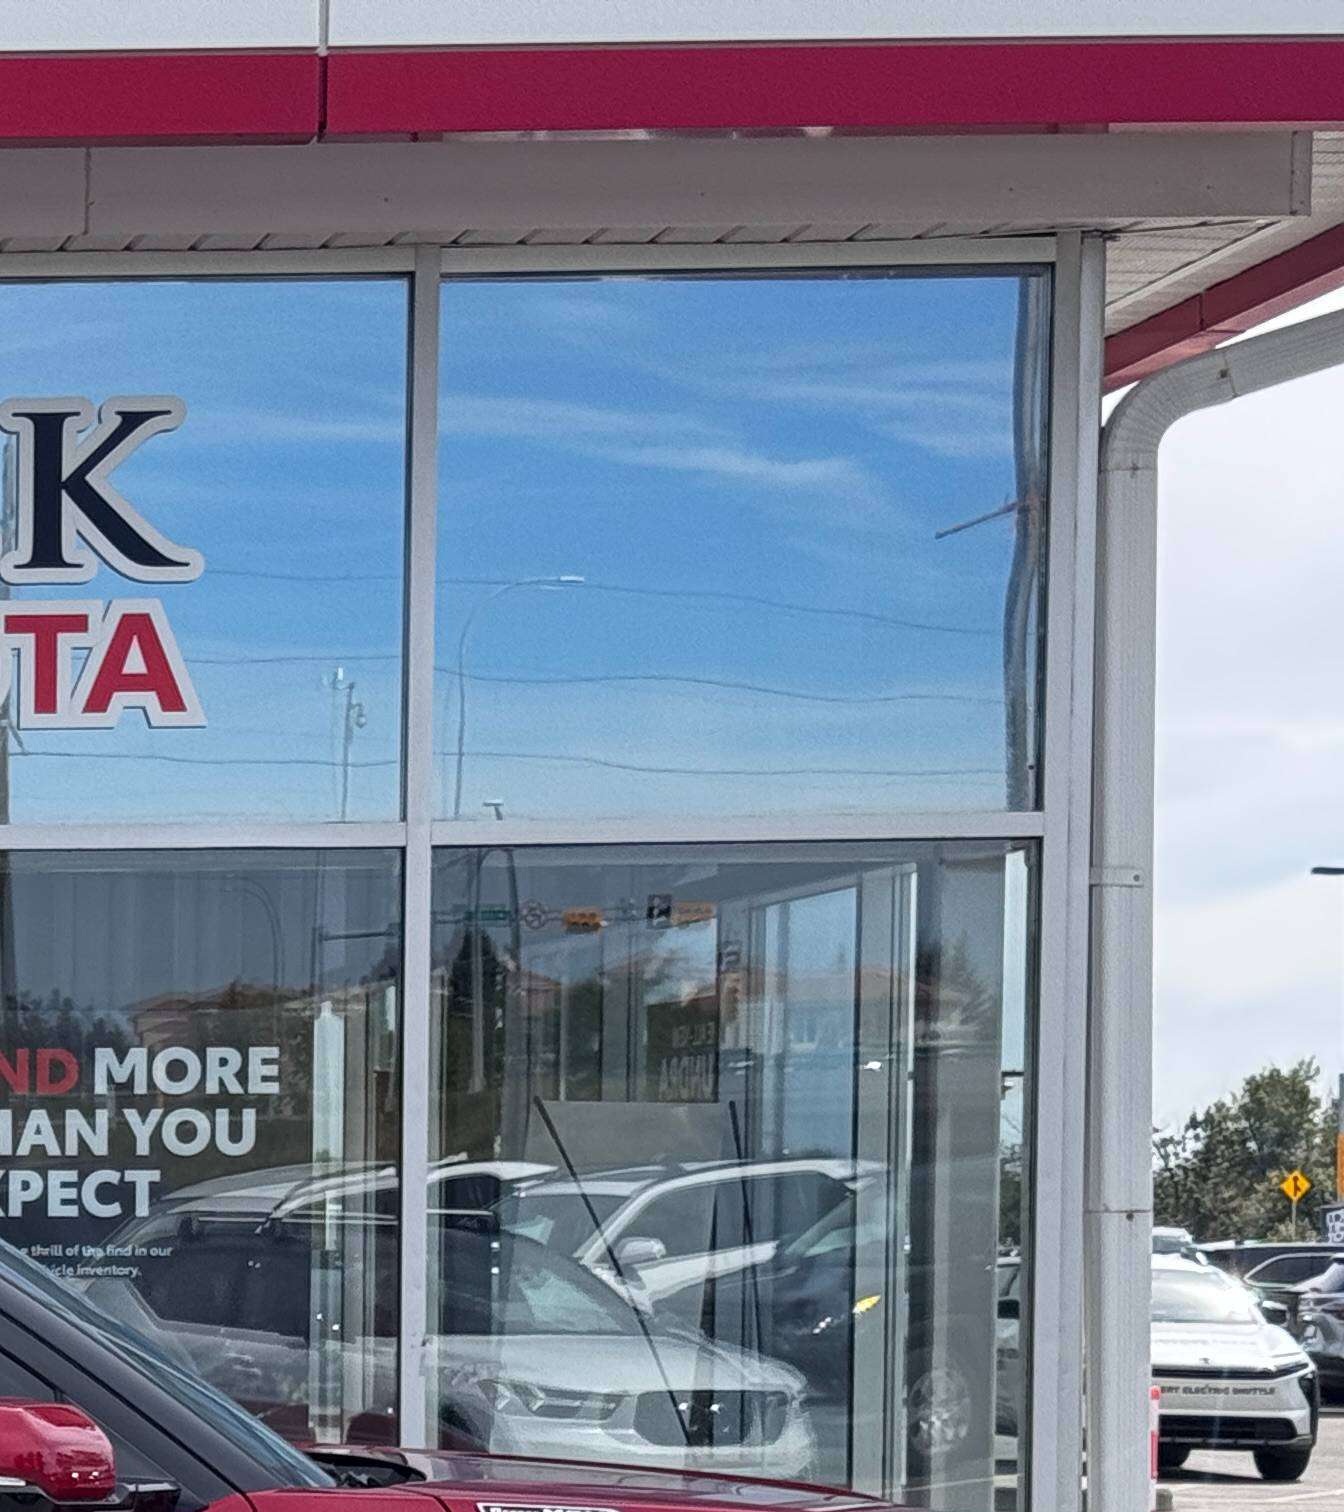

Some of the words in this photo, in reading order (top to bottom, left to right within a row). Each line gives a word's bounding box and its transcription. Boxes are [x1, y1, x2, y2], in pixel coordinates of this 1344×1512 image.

[94, 1046, 281, 1096] MORE
[122, 1107, 257, 1157] YOU
[30, 1244, 62, 1257] thrill
[65, 1244, 79, 1257] of
[106, 1244, 132, 1257] find
[135, 1245, 147, 1257] in
[150, 1246, 173, 1257] our
